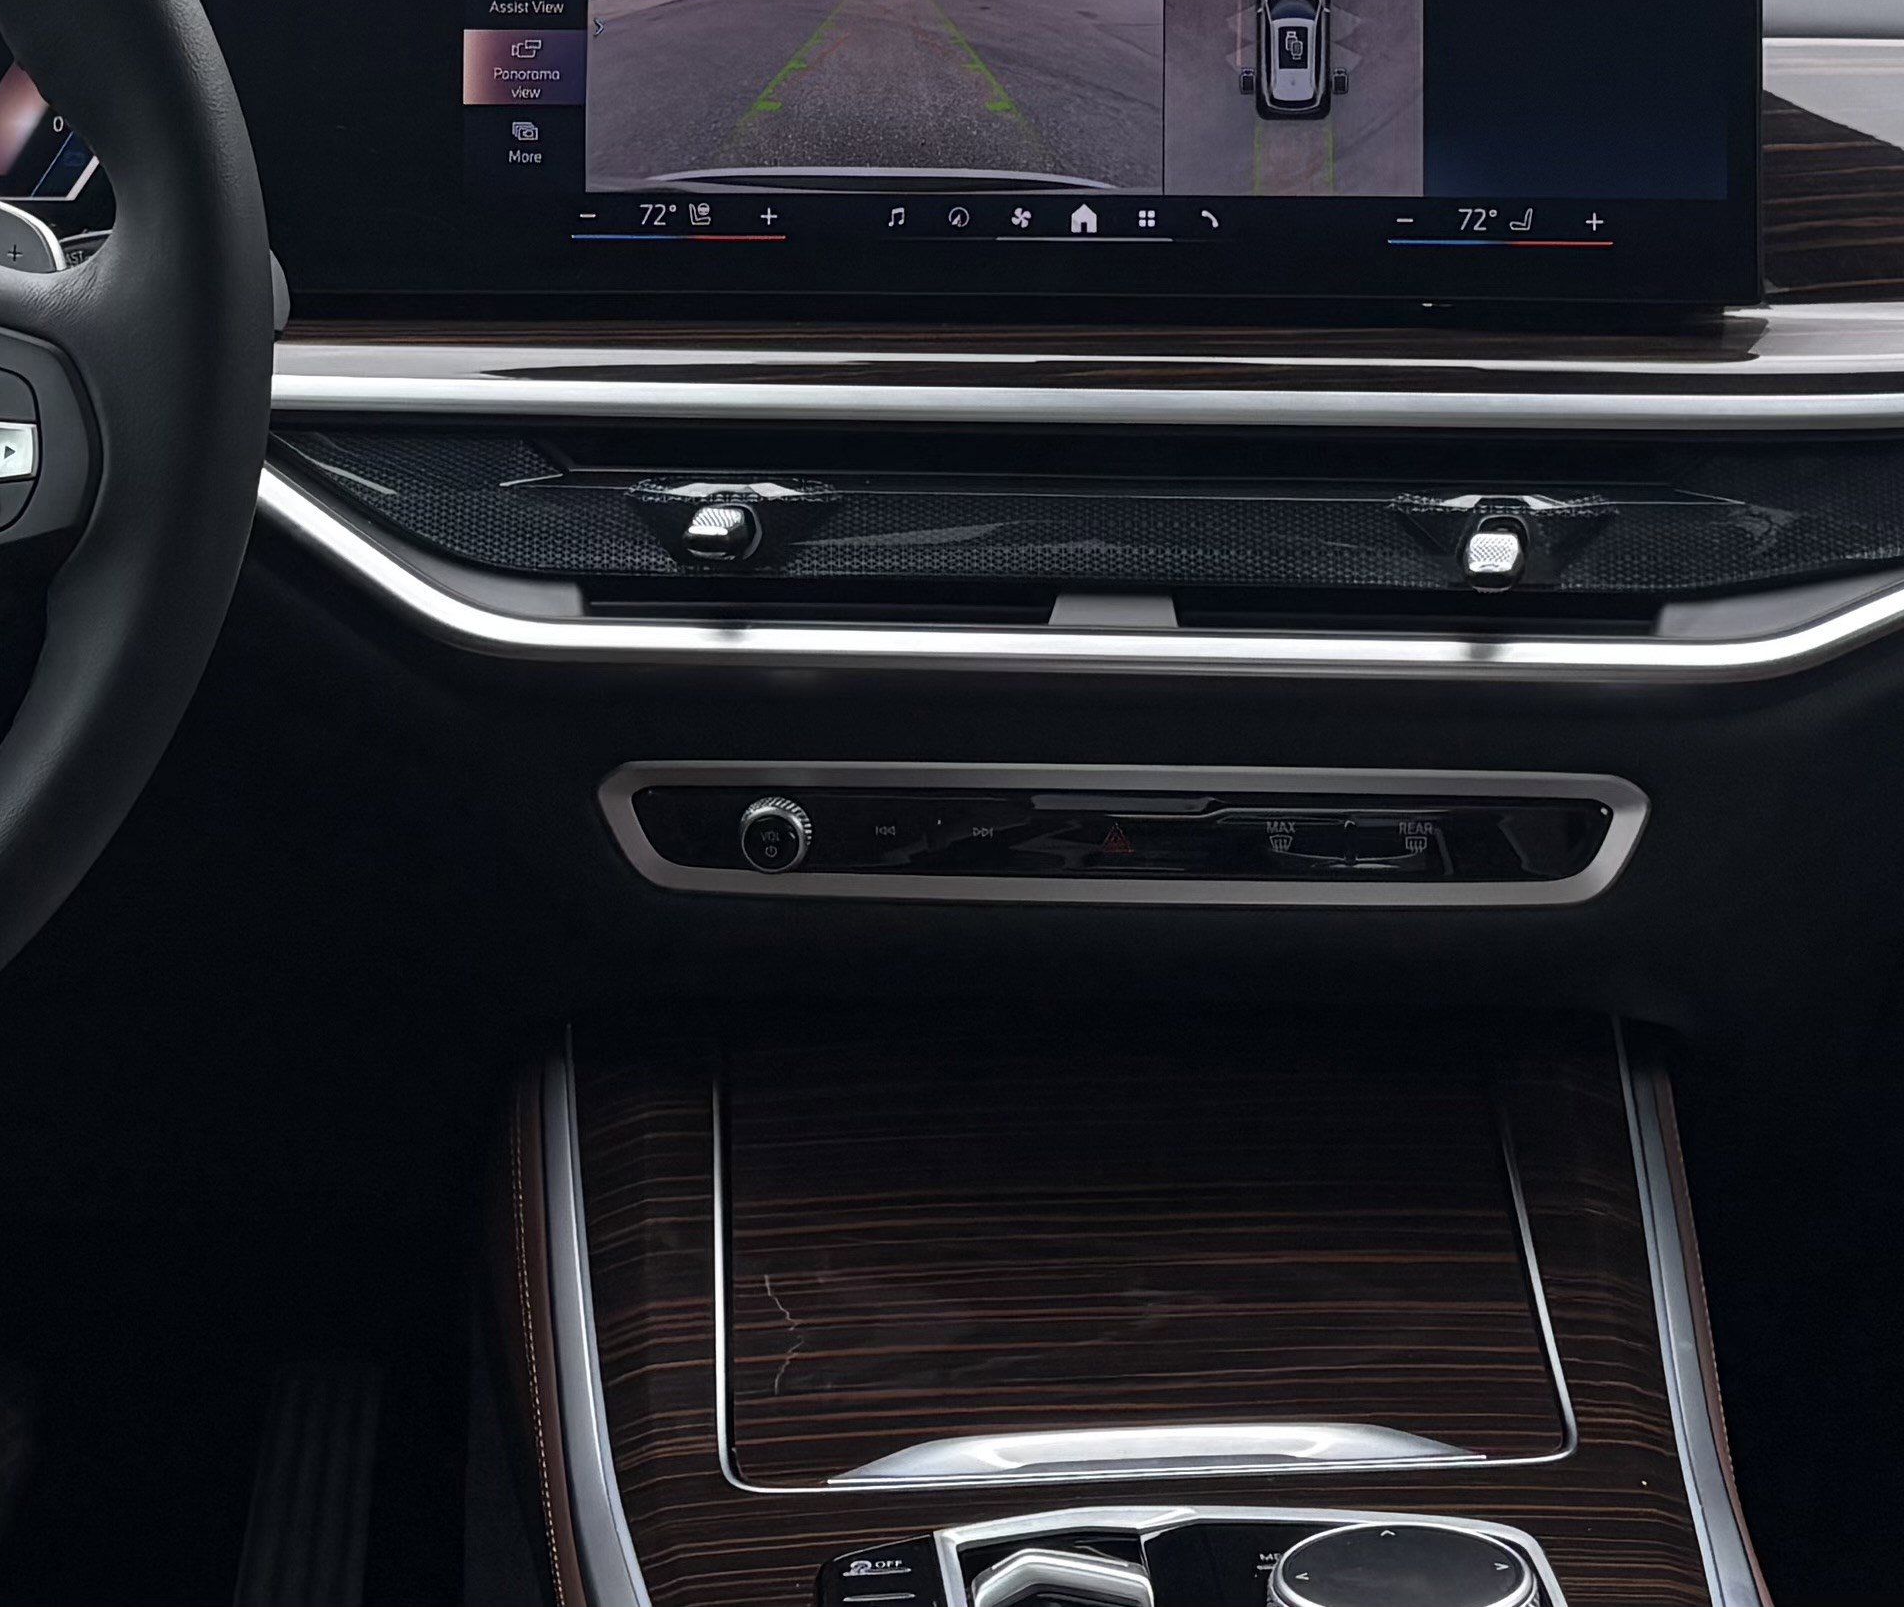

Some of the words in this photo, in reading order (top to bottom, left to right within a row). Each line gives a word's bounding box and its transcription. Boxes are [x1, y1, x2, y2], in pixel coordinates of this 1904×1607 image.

[489, 0, 529, 14] Assist
[532, 0, 564, 14] View
[493, 67, 561, 81] Panorama
[511, 86, 541, 99] view
[508, 149, 542, 164] More
[639, 203, 677, 226] 72°
[1458, 208, 1498, 231] 72°
[1266, 821, 1297, 834] MAX
[1399, 822, 1433, 835] REAR
[874, 1558, 904, 1570] OFF
